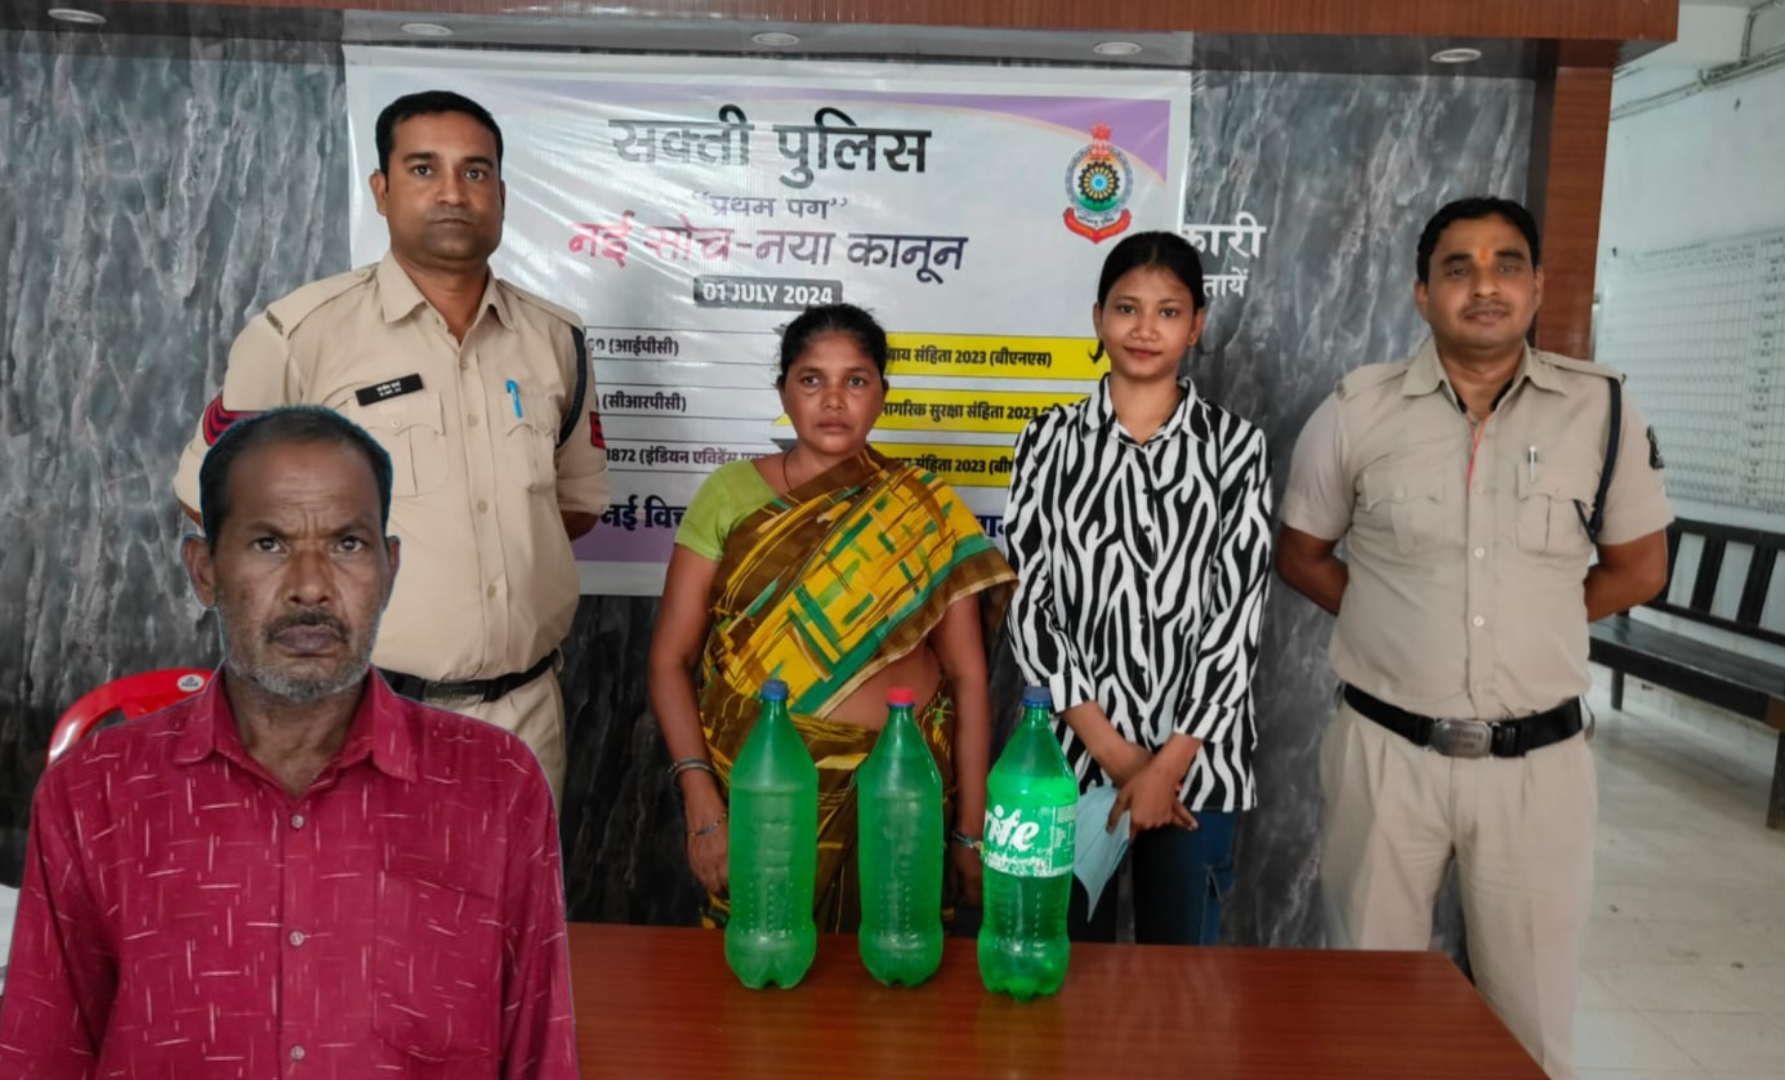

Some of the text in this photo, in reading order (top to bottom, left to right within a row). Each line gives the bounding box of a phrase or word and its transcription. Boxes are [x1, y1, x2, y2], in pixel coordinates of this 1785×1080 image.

[608, 104, 932, 189] सक्ती पुलिस
[569, 210, 635, 268] नई
[847, 233, 969, 284] कानून
[703, 282, 833, 306] 01 JULY 2024
[609, 335, 679, 357] (आईपीसी)
[914, 344, 953, 365] संहिता
[955, 350, 987, 365] 2023
[990, 347, 1053, 368] (बीएनएस)
[602, 390, 687, 413] (सीआरपीसी)
[929, 403, 964, 422] सुरक्षा
[966, 401, 1004, 421] संहिता
[1007, 405, 1038, 420] 2023
[606, 448, 636, 463] 1872
[639, 445, 689, 466] (इंडियन
[955, 459, 986, 473] 2023
[601, 494, 638, 531] नई
